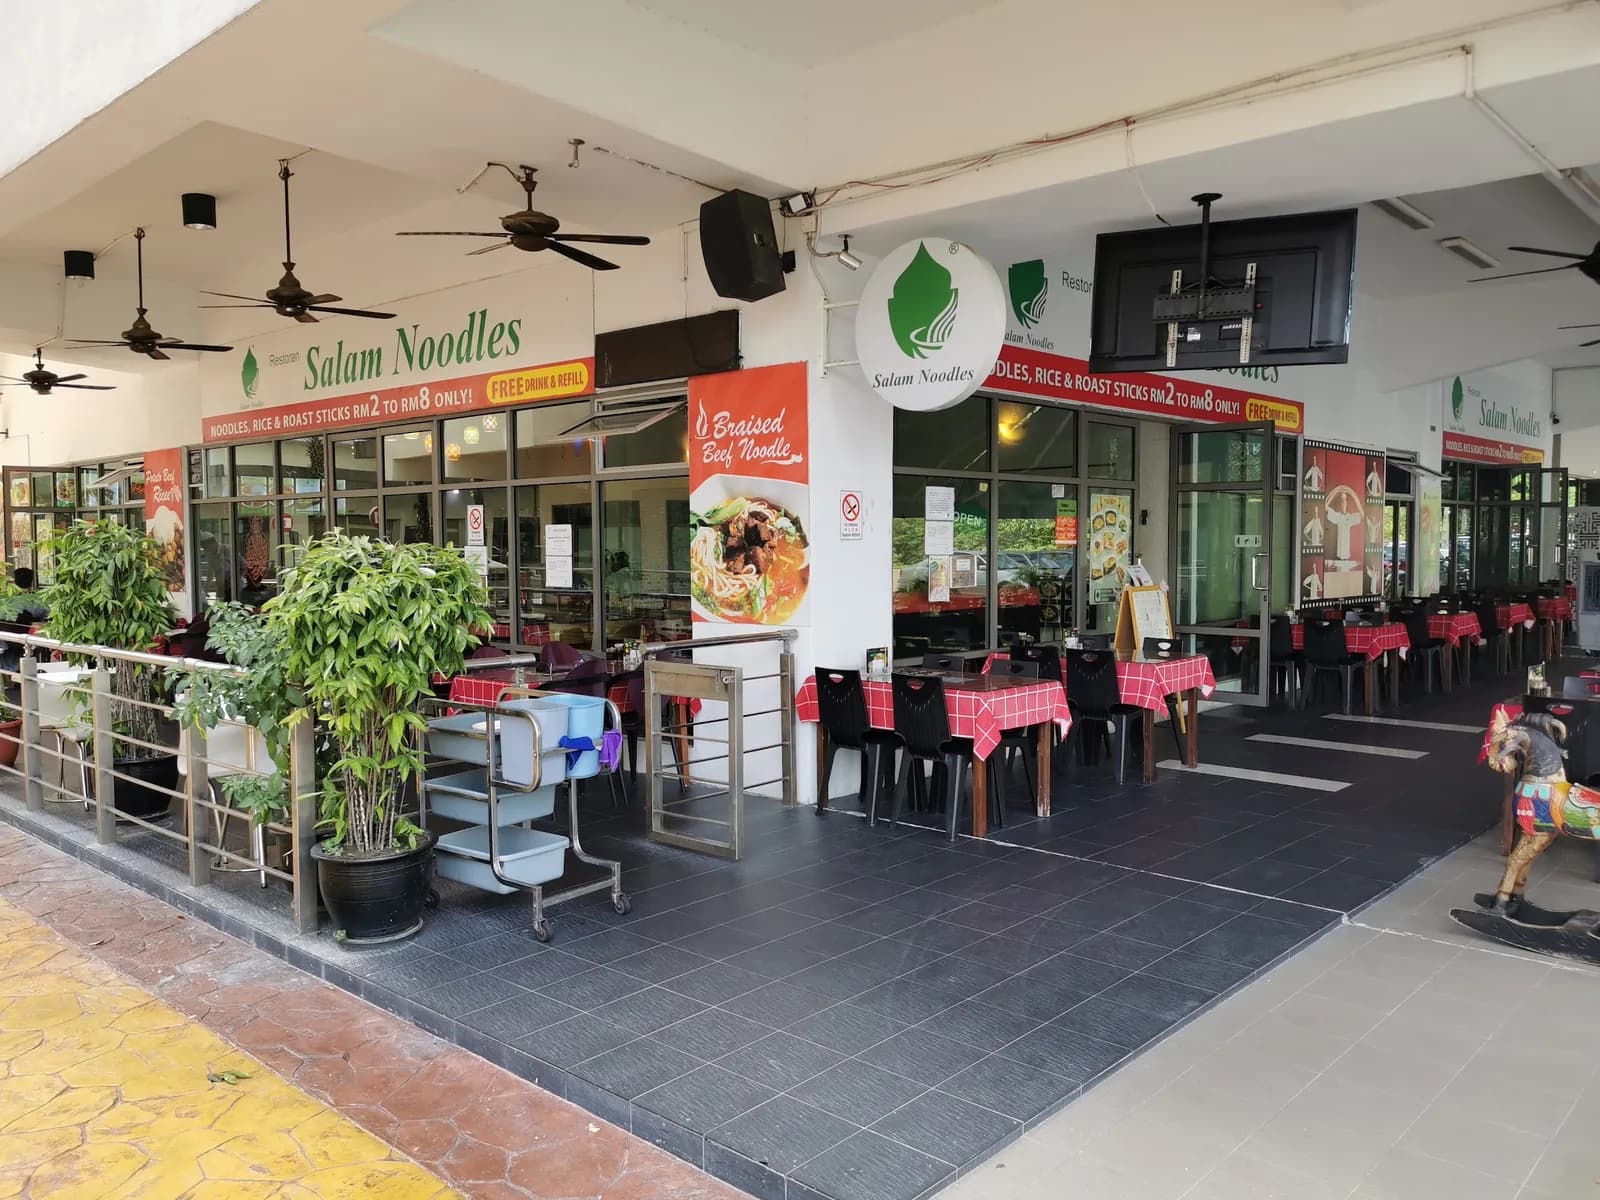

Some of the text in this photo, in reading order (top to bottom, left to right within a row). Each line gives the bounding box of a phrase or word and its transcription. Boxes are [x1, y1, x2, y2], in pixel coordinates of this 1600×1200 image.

[1062, 271, 1093, 295] Restor
[304, 308, 522, 391] Salam Noodles
[1004, 331, 1055, 350] alam Noodles
[269, 351, 300, 367] Restoran
[491, 370, 584, 399] FREE DRINK & REFILL
[872, 366, 975, 389] Salam Noodles
[990, 359, 1240, 416] DLES, RICE & ROAST STICKS RM2 TO RM8 ONLY!
[210, 387, 473, 438] NOODLES, RICE & ROAST STICKS RM2 TO RM8 ONLY!
[712, 407, 786, 439] Braised
[1249, 402, 1269, 419] FREE
[702, 437, 792, 469] Beef Noodle
[953, 512, 982, 527] OPEN
